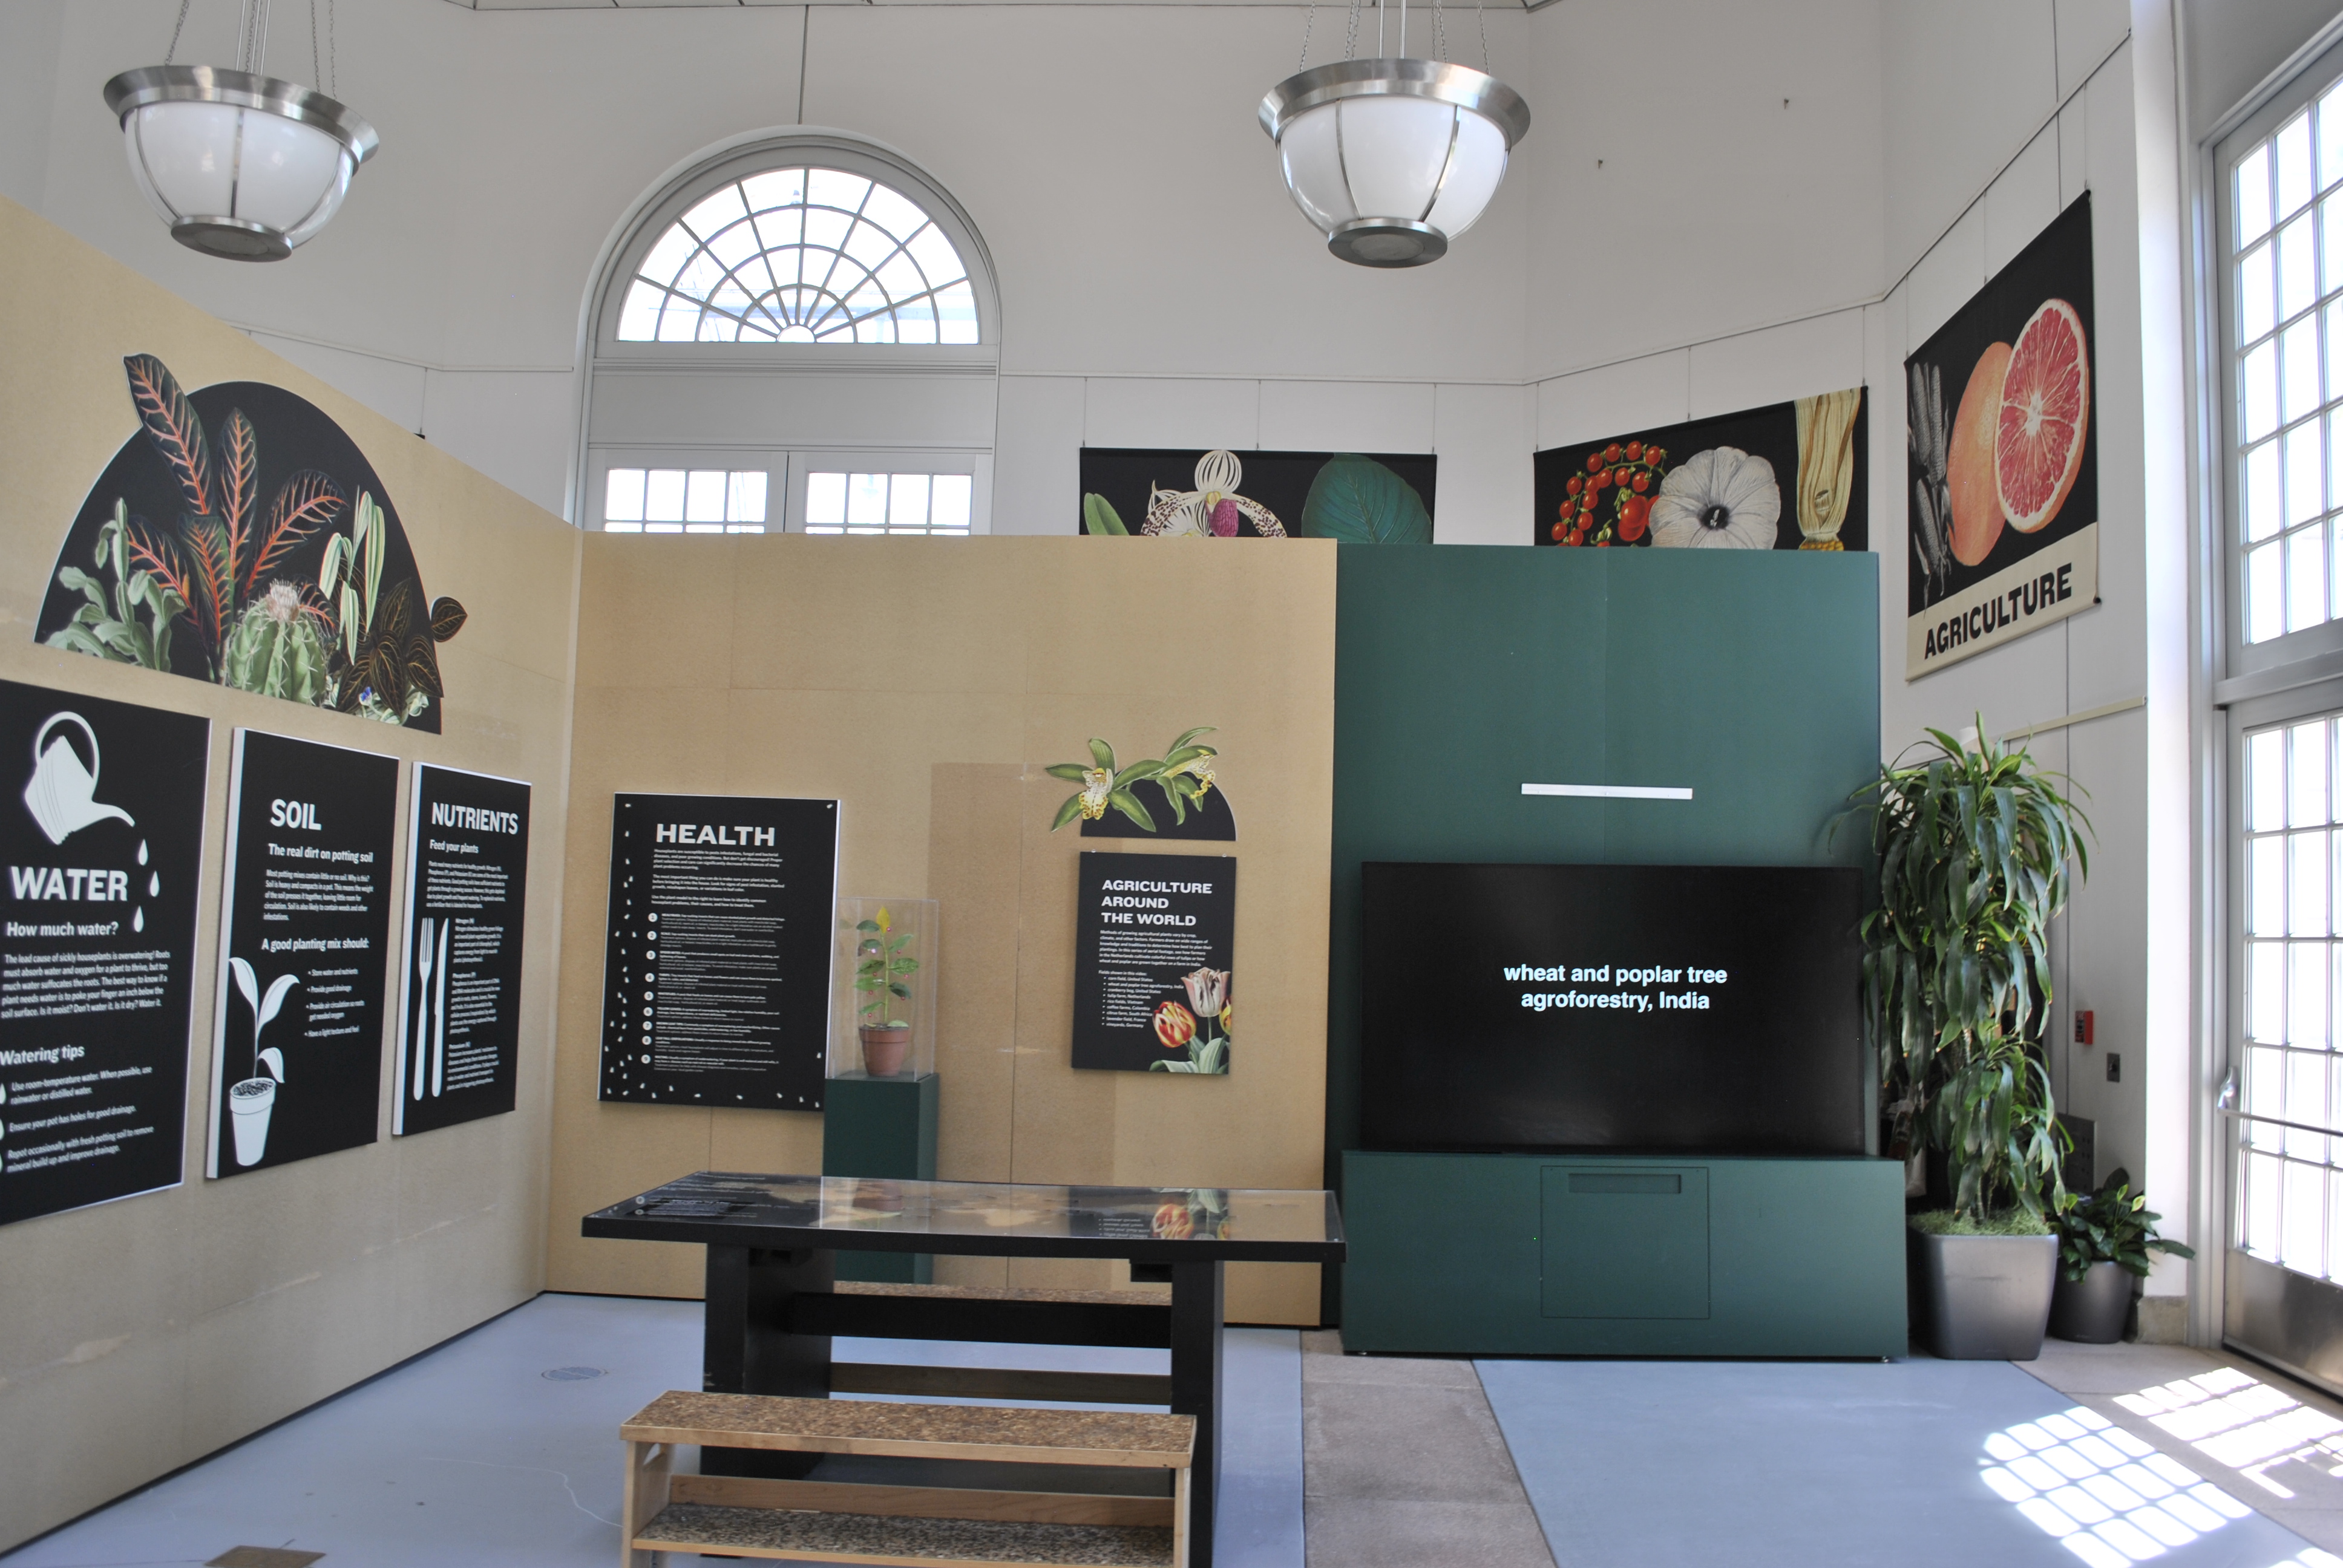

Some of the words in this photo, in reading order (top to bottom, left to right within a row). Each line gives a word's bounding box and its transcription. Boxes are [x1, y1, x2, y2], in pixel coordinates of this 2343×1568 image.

[1924, 562, 2072, 660] AGRICULTURE
[270, 799, 322, 831] SOIL
[431, 802, 519, 835] NUTRIENTS
[656, 823, 775, 846] HEALTH
[268, 843, 286, 856] The
[287, 846, 303, 857] real
[304, 847, 320, 858] dirt
[321, 851, 331, 859] on
[332, 851, 359, 864] potting
[360, 852, 373, 862] soil
[430, 839, 445, 850] Feed
[446, 843, 460, 852] your
[460, 843, 479, 854] plants
[10, 866, 128, 901] WATER
[1103, 880, 1212, 893] AGRICULTURE
[1101, 897, 1168, 908] AROUND
[7, 922, 38, 936] How
[40, 923, 74, 936] much
[77, 921, 119, 935] water?
[1101, 912, 1133, 923] THE
[1137, 914, 1196, 926] WORLD
[261, 938, 269, 950] A
[270, 939, 292, 952] good
[293, 938, 326, 952] planting
[327, 938, 341, 949] mix
[342, 938, 369, 949] should:
[5, 954, 18, 963] The
[18, 954, 33, 963] lead
[51, 953, 59, 962] of
[59, 953, 77, 962] sickly
[76, 952, 112, 961] houseplants
[112, 952, 118, 960] is
[117, 951, 155, 960] overwatering!
[4, 969, 21, 977] must
[21, 967, 44, 976] absorb
[62, 966, 74, 975] and
[74, 967, 96, 975] oxygen
[96, 964, 105, 973] for
[109, 964, 125, 973] plant
[131, 963, 149, 972] thrive,
[1504, 964, 1565, 981] wheat
[1571, 965, 1609, 982] and
[1616, 966, 1682, 986] poplar
[1687, 967, 1727, 983] tree
[2, 981, 21, 991] much
[40, 979, 73, 989] suffocates
[73, 978, 84, 987] the
[101, 976, 113, 985] The
[2, 996, 19, 1006] plant
[19, 994, 39, 1003] needs
[57, 992, 64, 1001] is
[71, 991, 87, 1001] poke
[87, 992, 100, 1001] your
[100, 990, 118, 999] finger
[125, 988, 138, 996] inch
[138, 987, 154, 996] below
[1521, 991, 1653, 1011] agroforestry,
[1660, 991, 1709, 1009] India
[0, 1048, 60, 1065] Watering
[61, 1045, 85, 1060] tips
